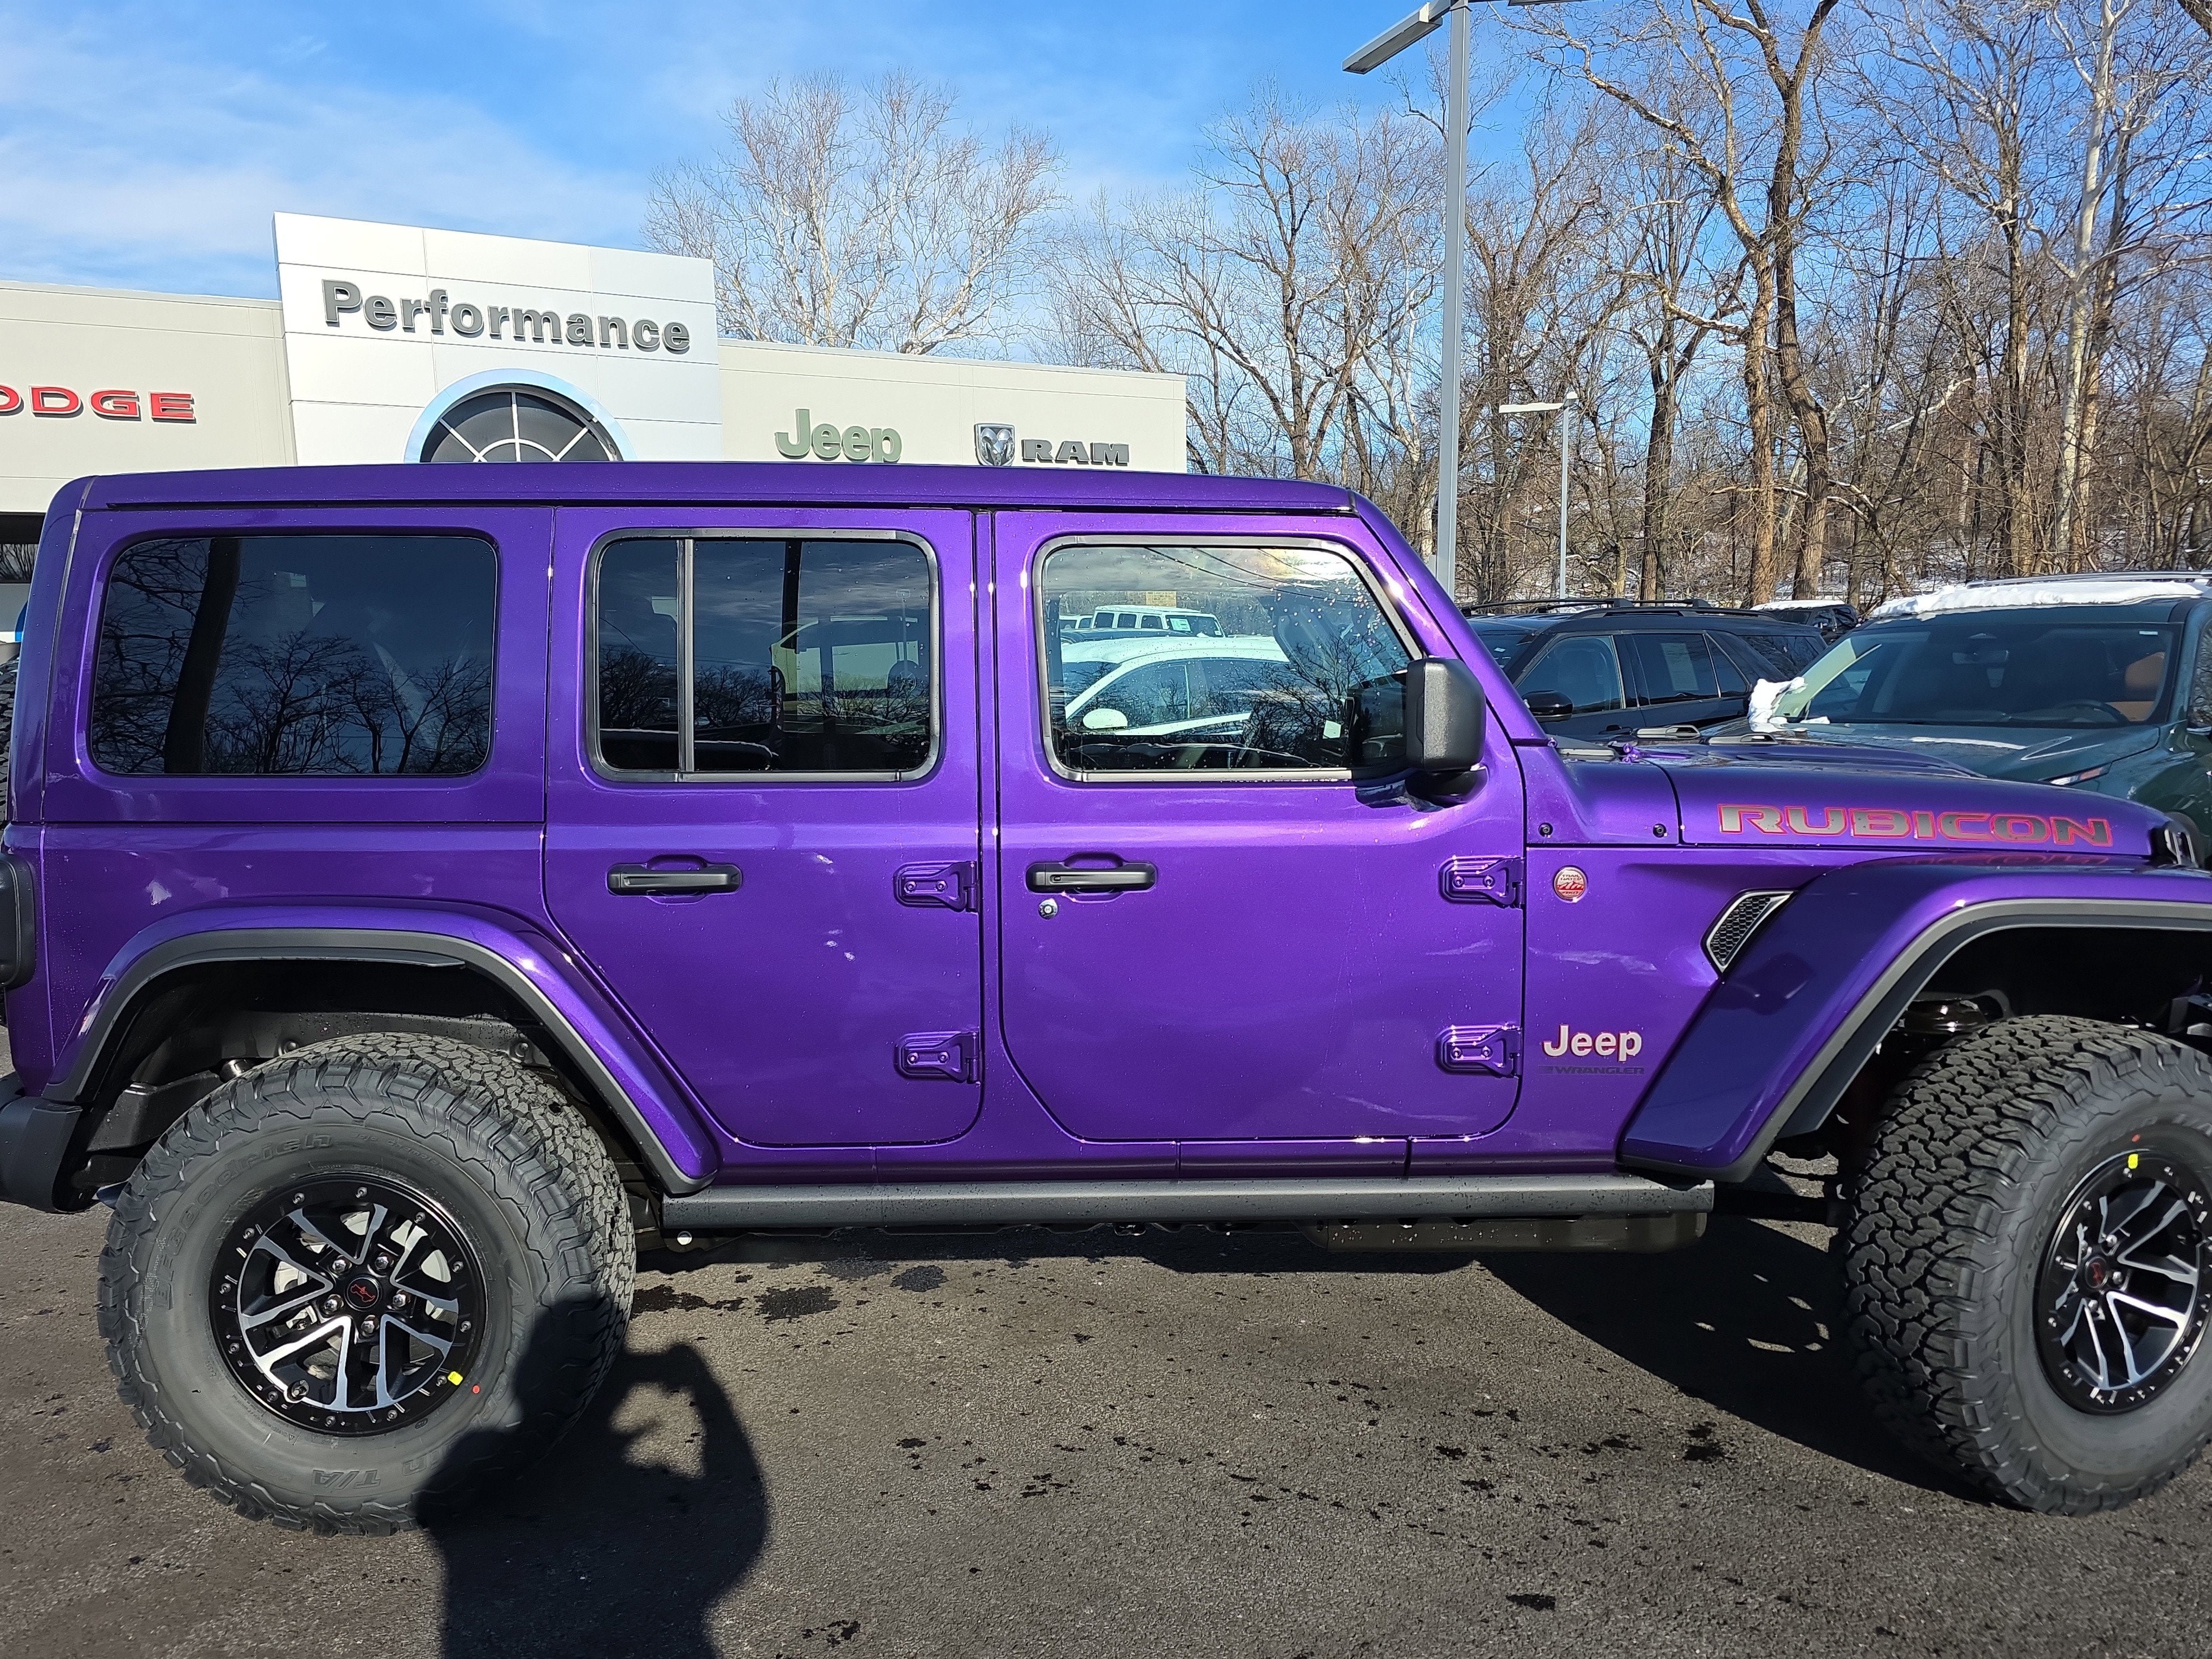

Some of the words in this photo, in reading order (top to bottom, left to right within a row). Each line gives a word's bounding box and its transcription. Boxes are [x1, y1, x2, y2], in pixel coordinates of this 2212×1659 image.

[321, 279, 690, 351] Performance
[774, 408, 902, 463] Jeep
[1023, 439, 1129, 465] RAM
[1718, 803, 2113, 846] RUBICON
[1542, 1024, 1642, 1062] Jeep
[1554, 1065, 1645, 1075] WRANGLER
[311, 1468, 381, 1490] T/A
